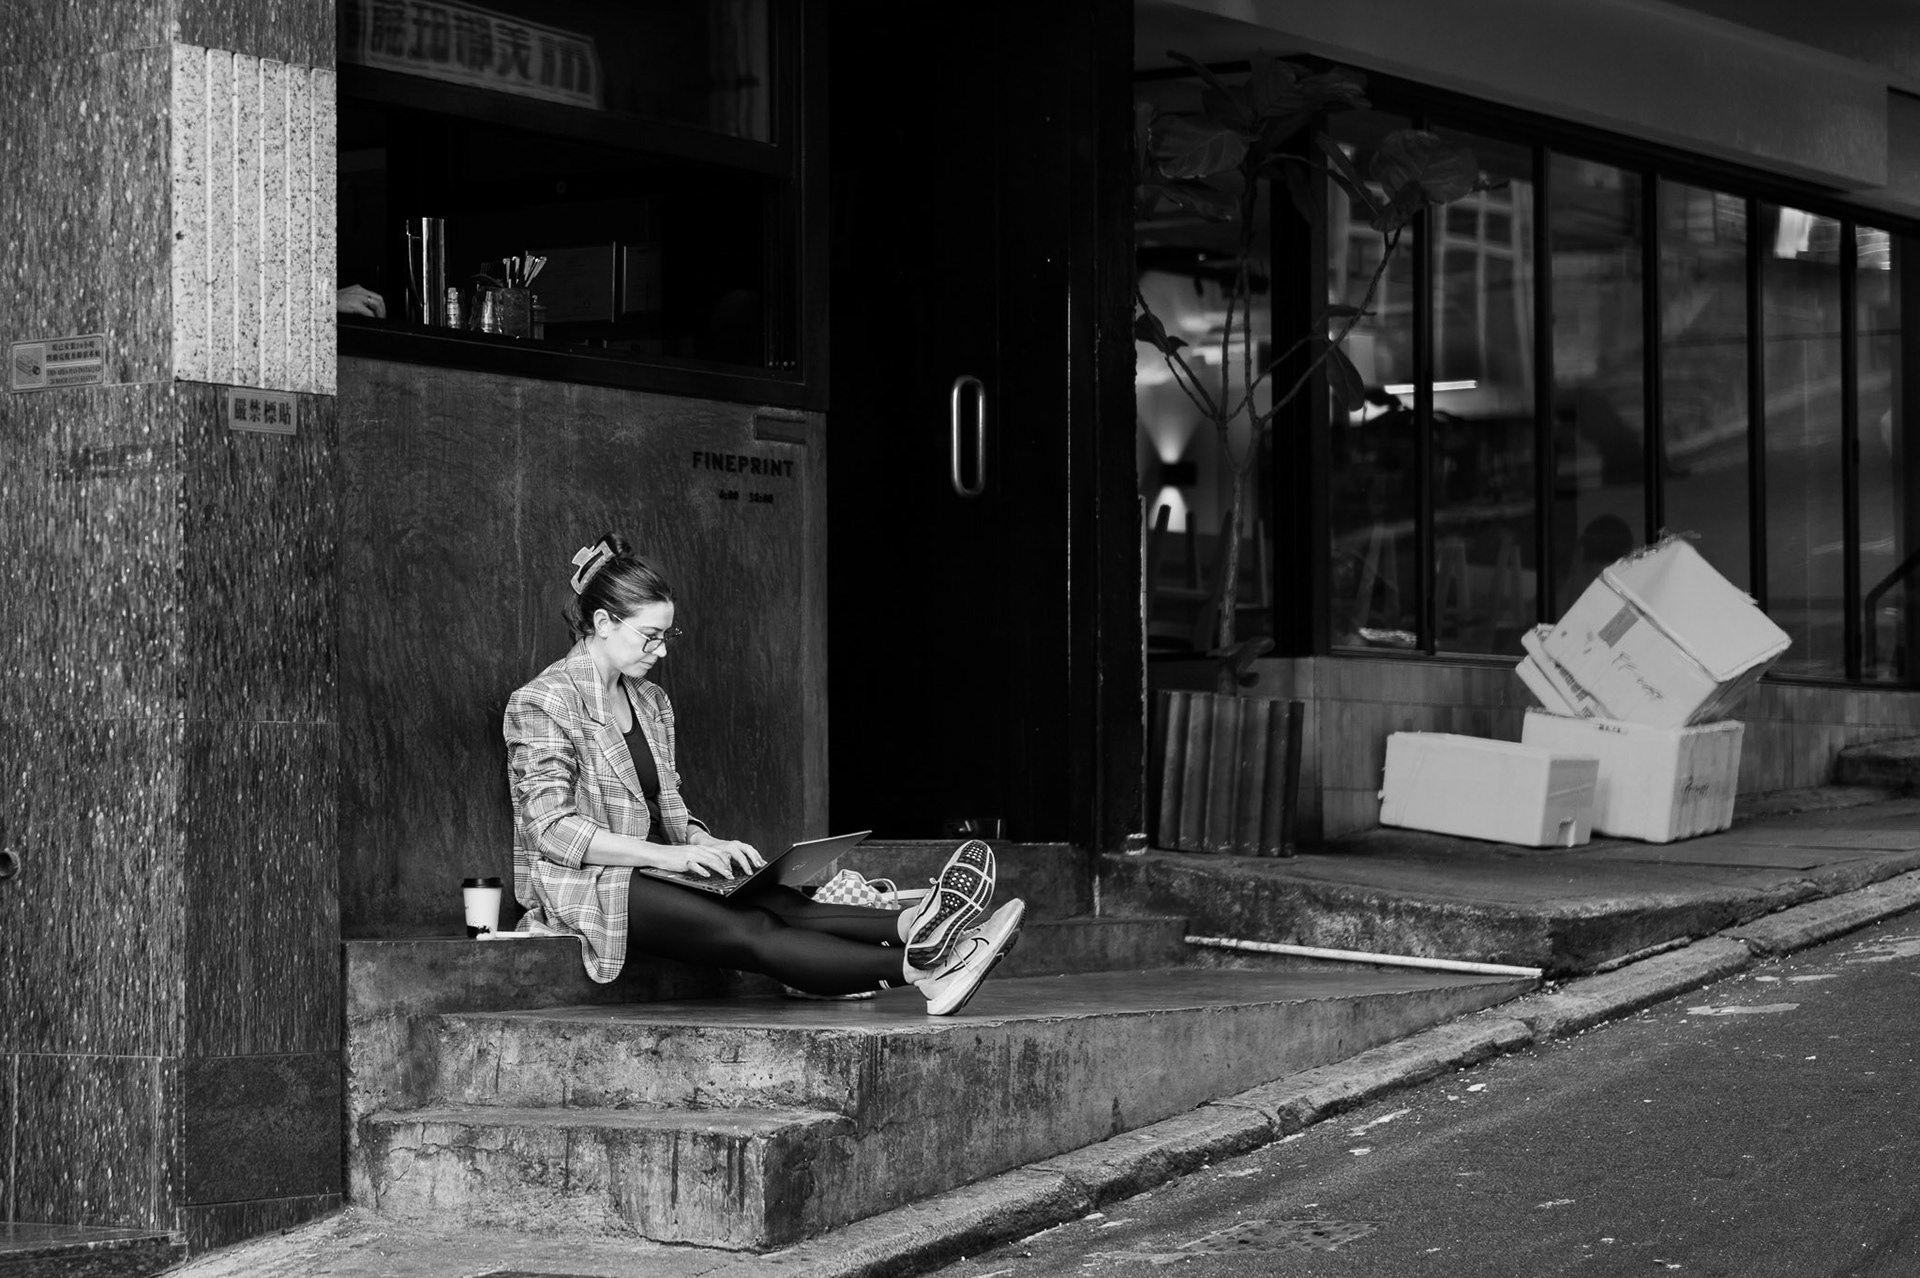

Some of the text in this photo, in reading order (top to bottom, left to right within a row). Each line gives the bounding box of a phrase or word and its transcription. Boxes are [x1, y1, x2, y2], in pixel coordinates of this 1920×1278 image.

[234, 398, 292, 425] 嚴禁標貼
[692, 451, 794, 477] FINEPRINT
